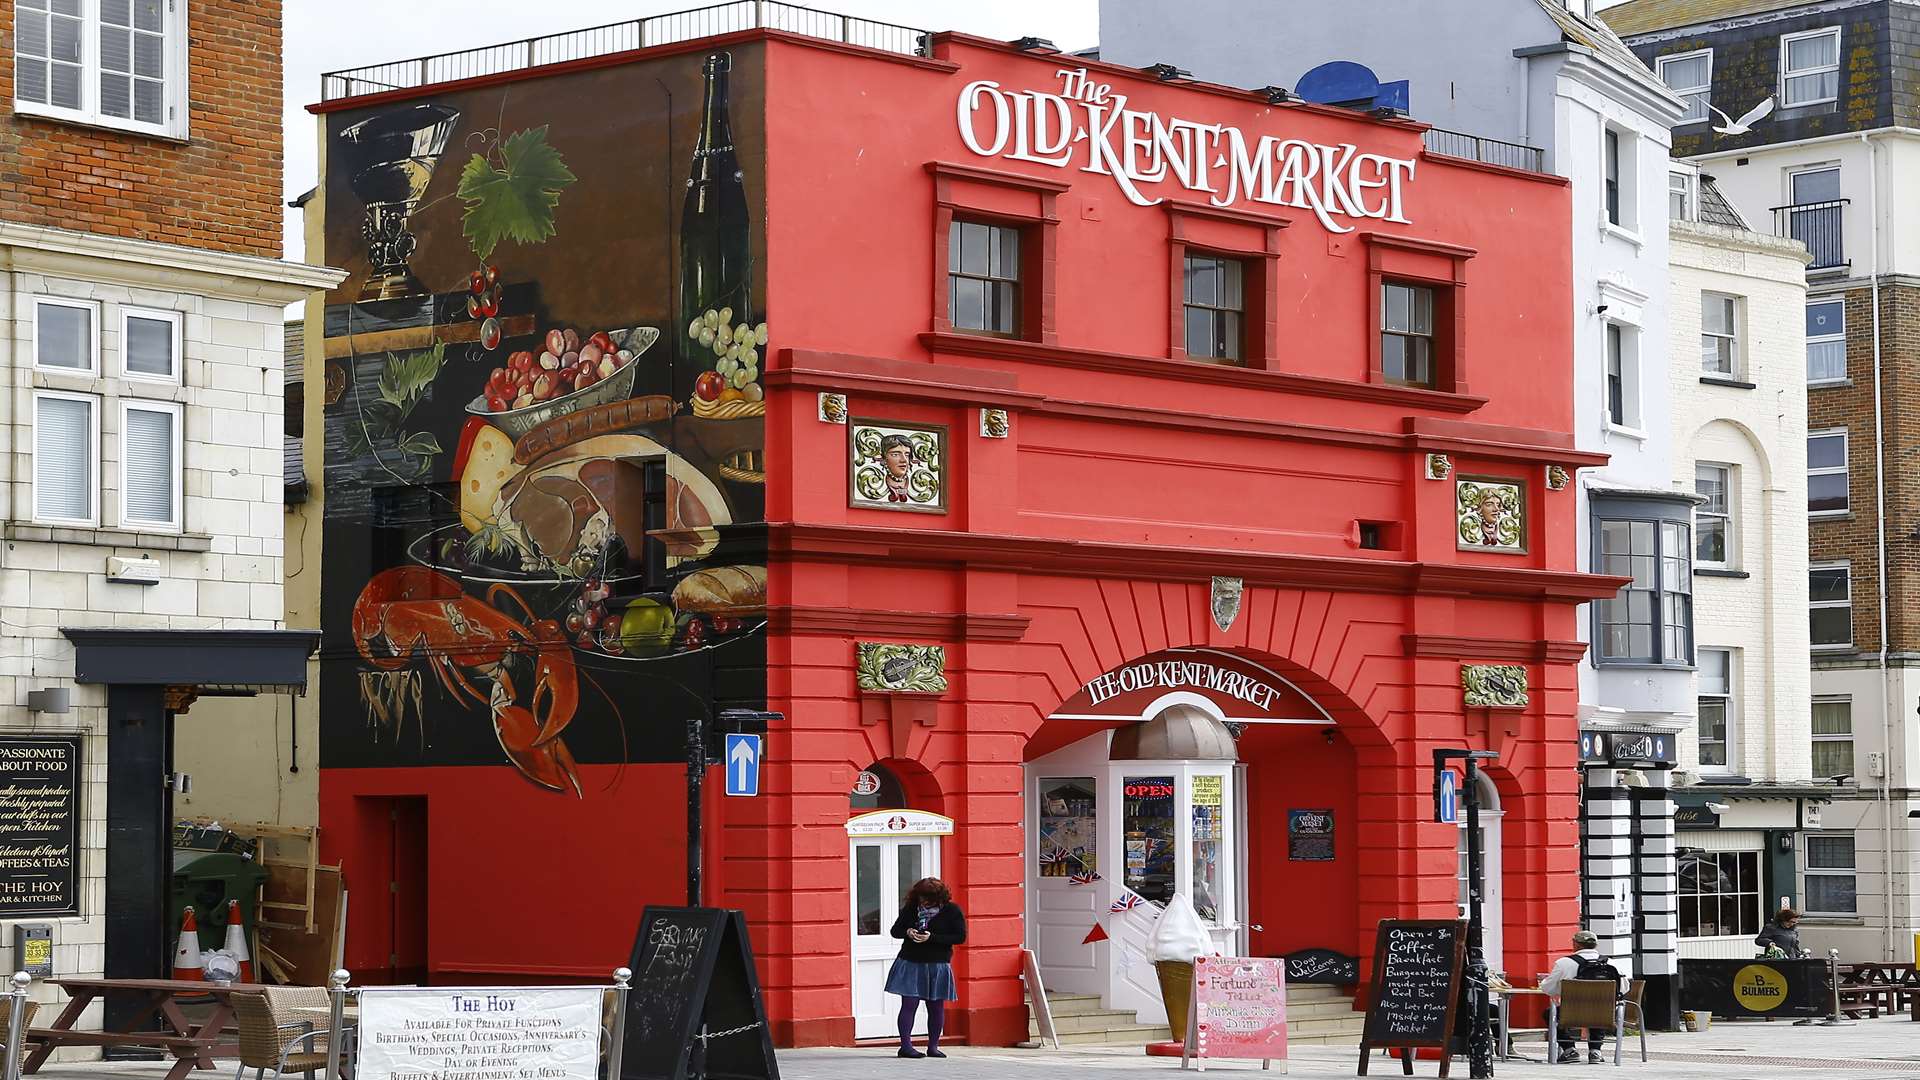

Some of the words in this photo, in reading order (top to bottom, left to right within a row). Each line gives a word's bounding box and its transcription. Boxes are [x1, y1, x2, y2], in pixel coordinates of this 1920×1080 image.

[1055, 68, 1113, 106] The
[957, 80, 1073, 168] OLD
[1075, 94, 1223, 206] KENT
[1211, 126, 1417, 234] MARKET
[1081, 671, 1121, 707] THE
[1118, 663, 1156, 692] OLD
[1155, 660, 1206, 688] KENT
[1205, 669, 1281, 712] MARKET
[35, 761, 68, 771] FOOD
[1125, 785, 1174, 797] OPEN
[39, 809, 50, 819] in
[51, 811, 69, 819] our
[20, 820, 62, 831] Kitchen
[33, 858, 41, 868] &
[42, 857, 70, 868] TEAS
[32, 881, 63, 893] HOY
[22, 895, 62, 903] KITCHEN
[1389, 929, 1425, 941] Open
[1389, 940, 1435, 954] Coffee
[1291, 956, 1317, 969] Dogs
[1387, 952, 1446, 966] Breakfast
[1289, 958, 1337, 978] Welcome
[1210, 976, 1257, 990] Fortune
[1431, 979, 1449, 987] the
[1391, 988, 1412, 997] Red
[1741, 985, 1780, 996] BULMERS
[452, 995, 481, 1012] THE
[486, 994, 517, 1012] HOY
[403, 1018, 451, 1029] AVAILABLE
[455, 1017, 473, 1028] FOR
[476, 1017, 513, 1028] PRIVATE
[515, 1017, 562, 1028] FUNCTIONS
[376, 1032, 428, 1043] BIRTHDAYS,
[431, 1031, 467, 1042] SPECIAL
[408, 1045, 458, 1056] WEDDINGS,
[460, 1044, 498, 1055] PRIVATE
[444, 1057, 462, 1068] DAY
[465, 1058, 478, 1068] OR
[480, 1056, 518, 1067] EVENING
[390, 1071, 428, 1080] BUFFETS
[430, 1070, 439, 1080] &
[519, 1068, 534, 1078] SET
[537, 1067, 567, 1078] MENUS
